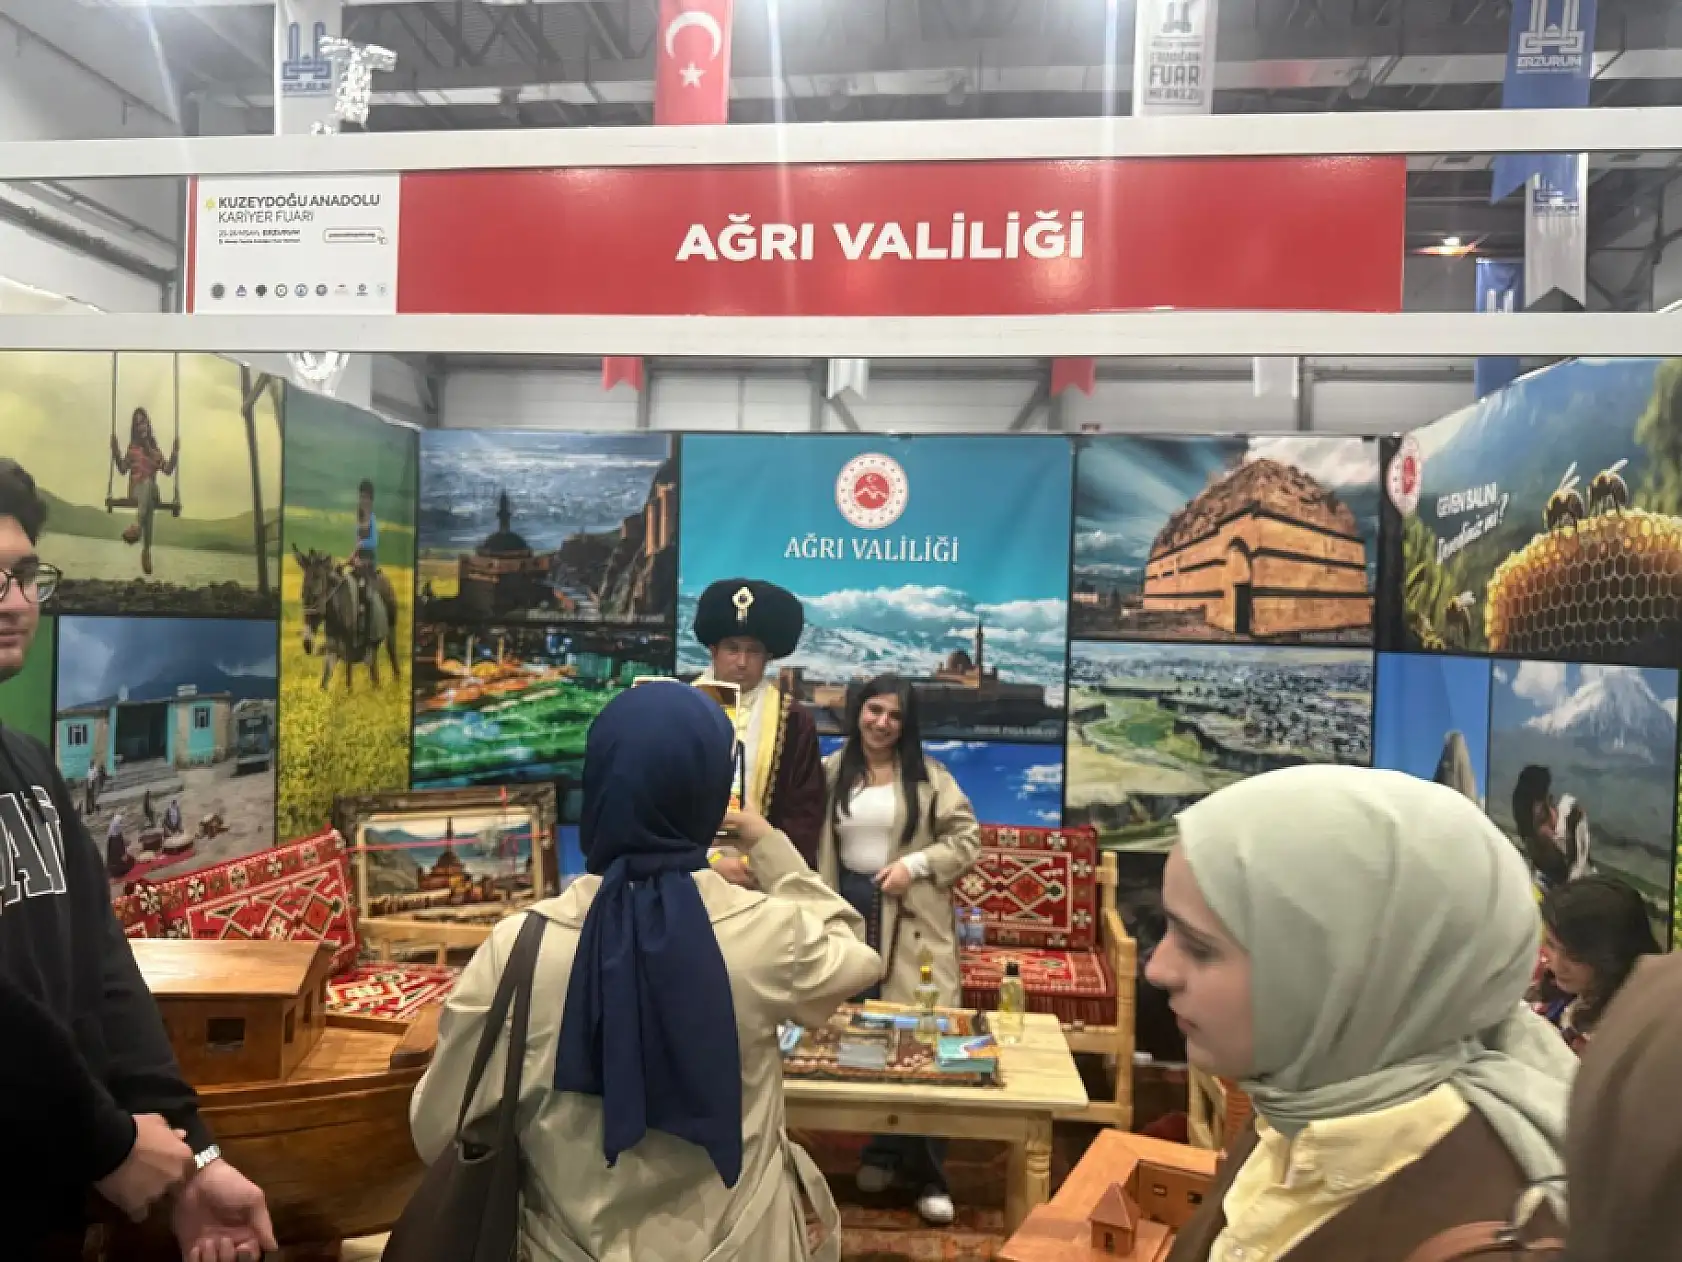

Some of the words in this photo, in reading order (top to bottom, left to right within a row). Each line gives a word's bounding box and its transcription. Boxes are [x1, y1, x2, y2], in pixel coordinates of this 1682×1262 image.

[1149, 65, 1199, 87] FUAR
[218, 193, 307, 208] KUZEYDOĞU
[309, 194, 381, 207] ANADOLU
[218, 211, 273, 223] KARİYER
[275, 211, 314, 223] FUARI
[675, 213, 814, 262] AĞRI
[832, 210, 1085, 261] VALİLİĞİ
[783, 532, 844, 559] AĞRI
[851, 535, 960, 564] VALİLİĞİ
